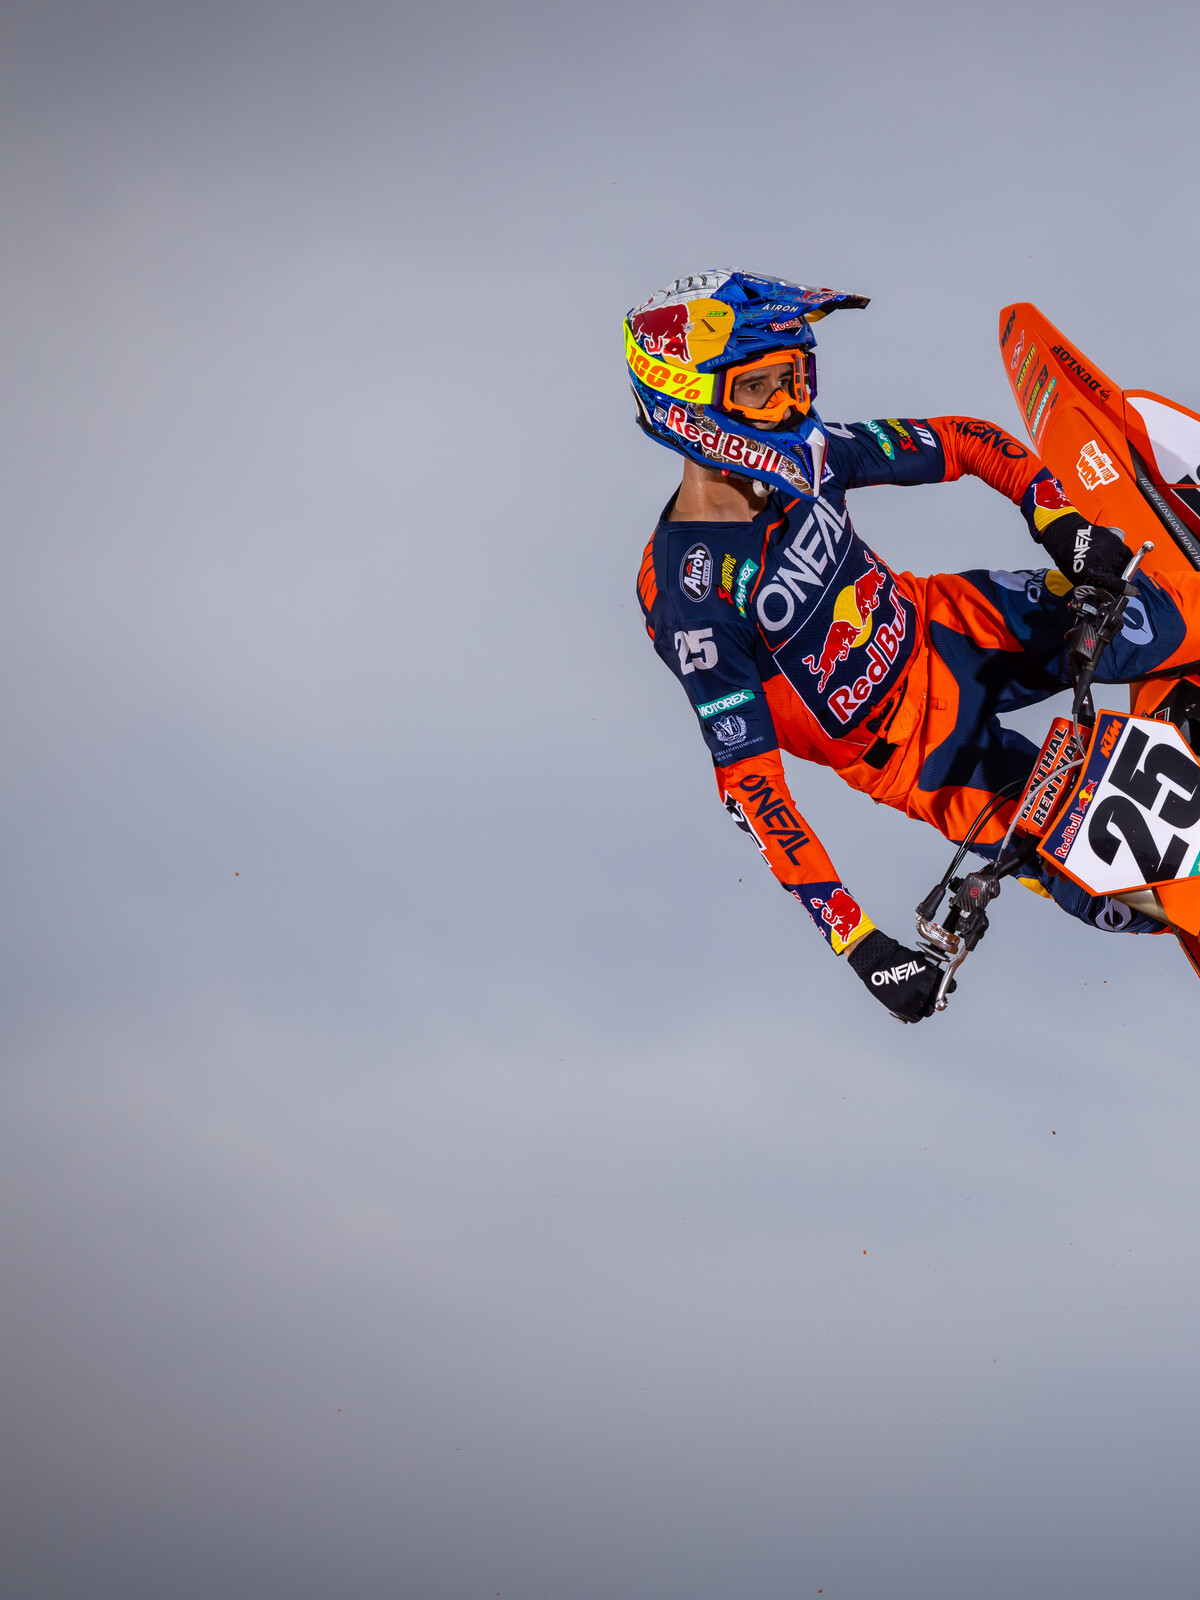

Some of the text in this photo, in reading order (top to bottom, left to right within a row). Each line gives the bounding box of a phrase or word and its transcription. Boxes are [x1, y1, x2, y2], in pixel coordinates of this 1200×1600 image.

[762, 303, 799, 312] AIROH
[629, 345, 702, 400] 100%
[706, 355, 732, 367] AIROH
[1051, 345, 1101, 392] DUNLOP
[666, 404, 723, 452] Red
[721, 433, 783, 474] Bull
[1156, 500, 1186, 539] UNIVERSITY
[683, 549, 706, 595] Airoh
[674, 627, 719, 675] 25
[827, 584, 909, 724] Red Bull
[698, 691, 749, 718] MOTOREX
[1100, 719, 1123, 759] KTM
[1055, 813, 1083, 858] Red Bull
